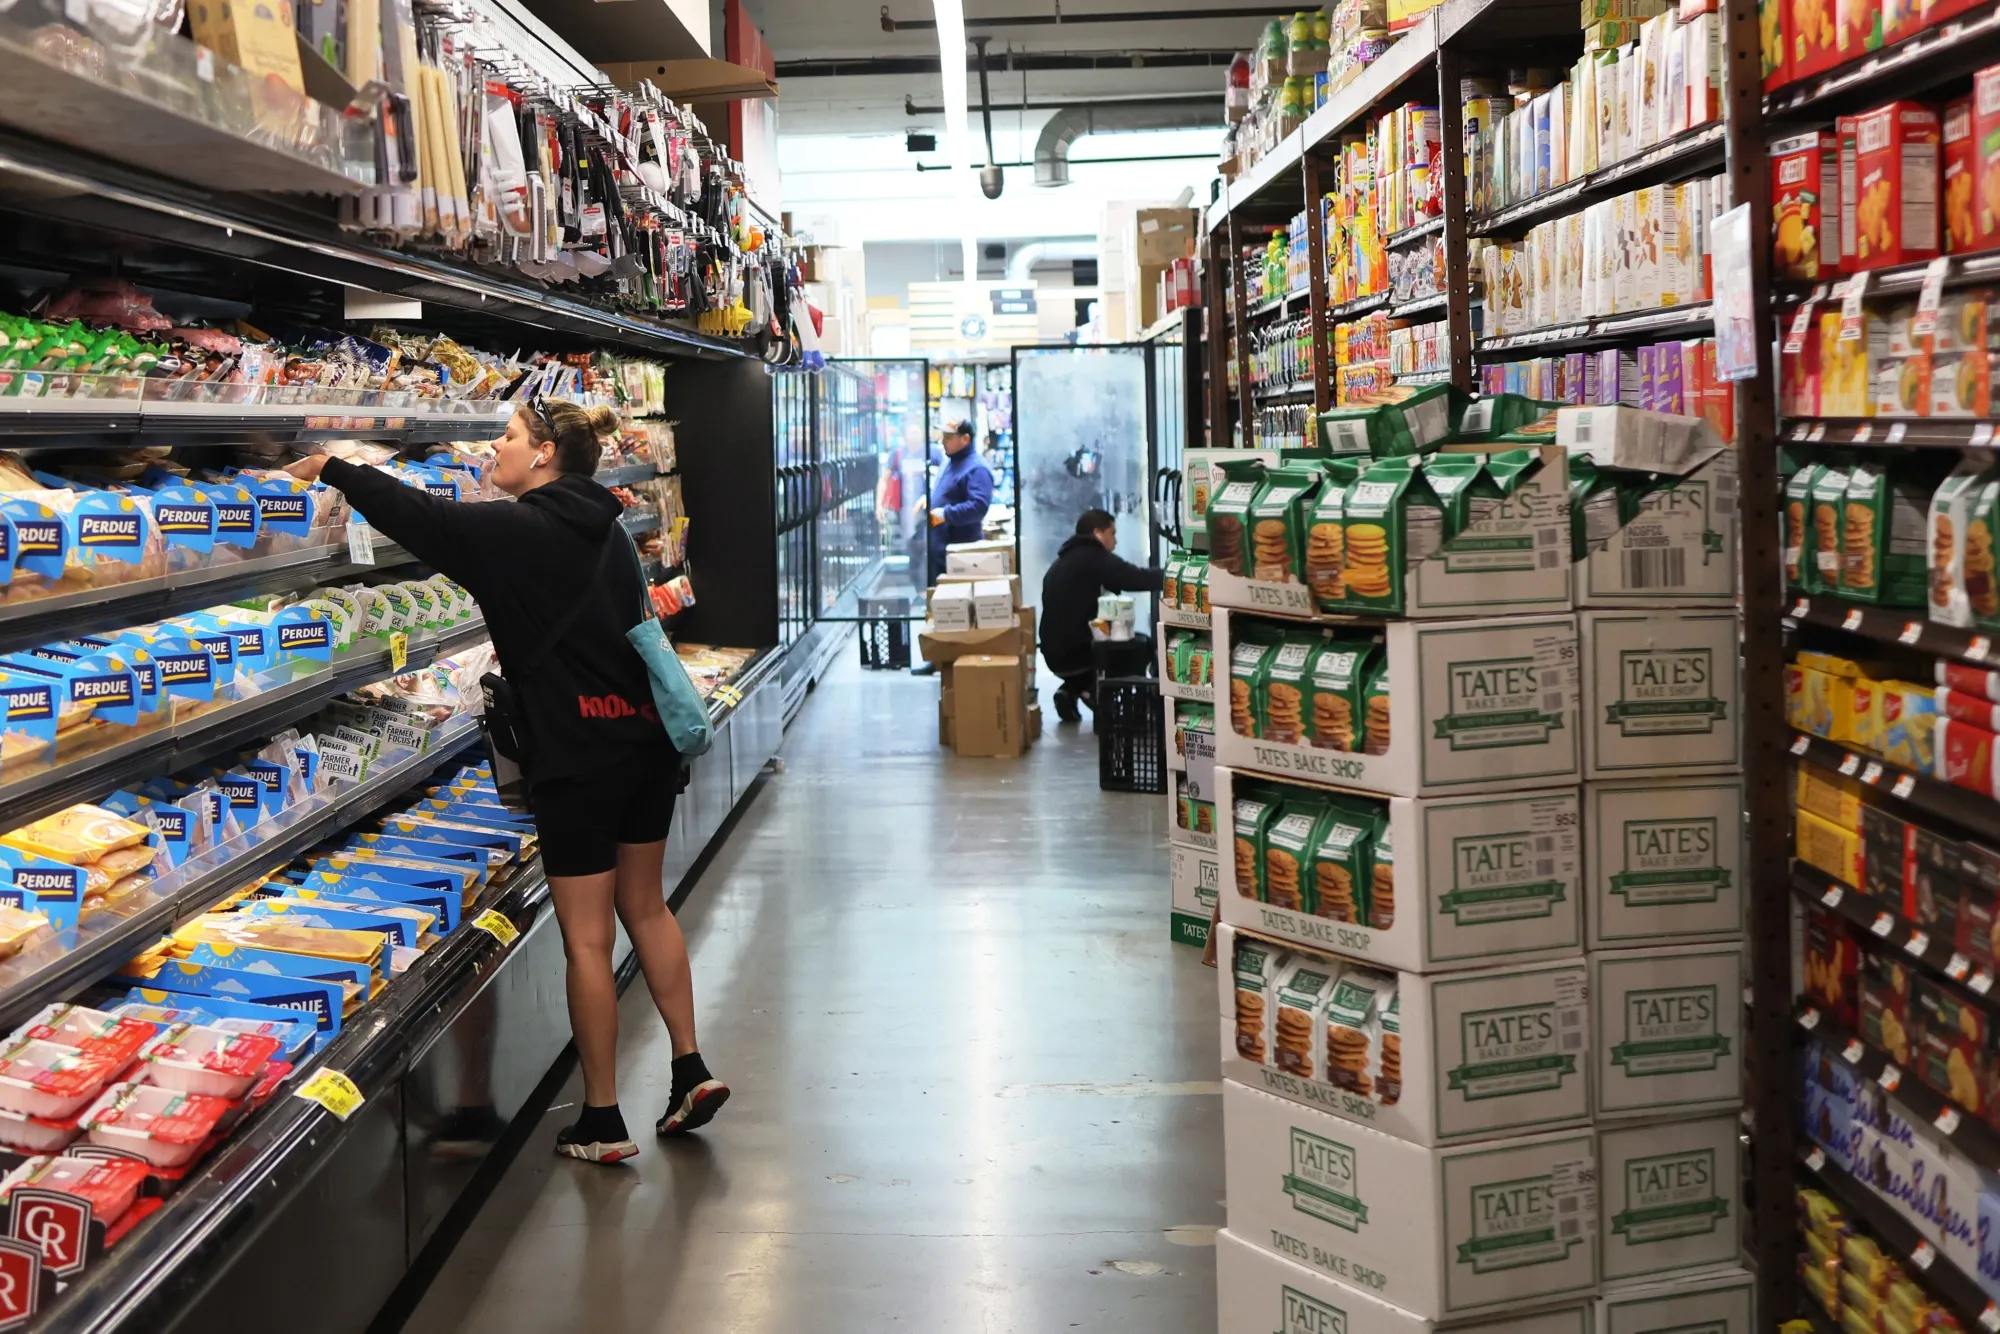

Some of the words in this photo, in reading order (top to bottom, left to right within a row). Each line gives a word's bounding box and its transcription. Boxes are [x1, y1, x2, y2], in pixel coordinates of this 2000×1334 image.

[259, 499, 304, 511] PERDUE
[158, 508, 208, 523] PERDUE
[82, 518, 136, 534] PERDUE
[281, 627, 324, 640] PERDUE
[36, 651, 49, 659] NO
[158, 658, 206, 674] PERDUE
[74, 680, 128, 697] PERDUE
[336, 729, 364, 744] FARMER
[386, 724, 414, 739] FARMER
[387, 733, 411, 745] FOCUS
[321, 751, 350, 766] FARMER
[1294, 752, 1326, 775] BAKE
[1332, 758, 1365, 780] SHOP
[322, 761, 347, 774] FOCUS
[17, 872, 73, 888] PERDUE
[1300, 918, 1334, 943] BAKE
[1337, 928, 1370, 951] SHOP
[1469, 1012, 1553, 1048] TATE'S
[1303, 1082, 1339, 1108] BAKE
[1343, 1094, 1377, 1120] SHOP
[1313, 1247, 1348, 1276] BAKE
[1352, 1263, 1387, 1292] SHOP
